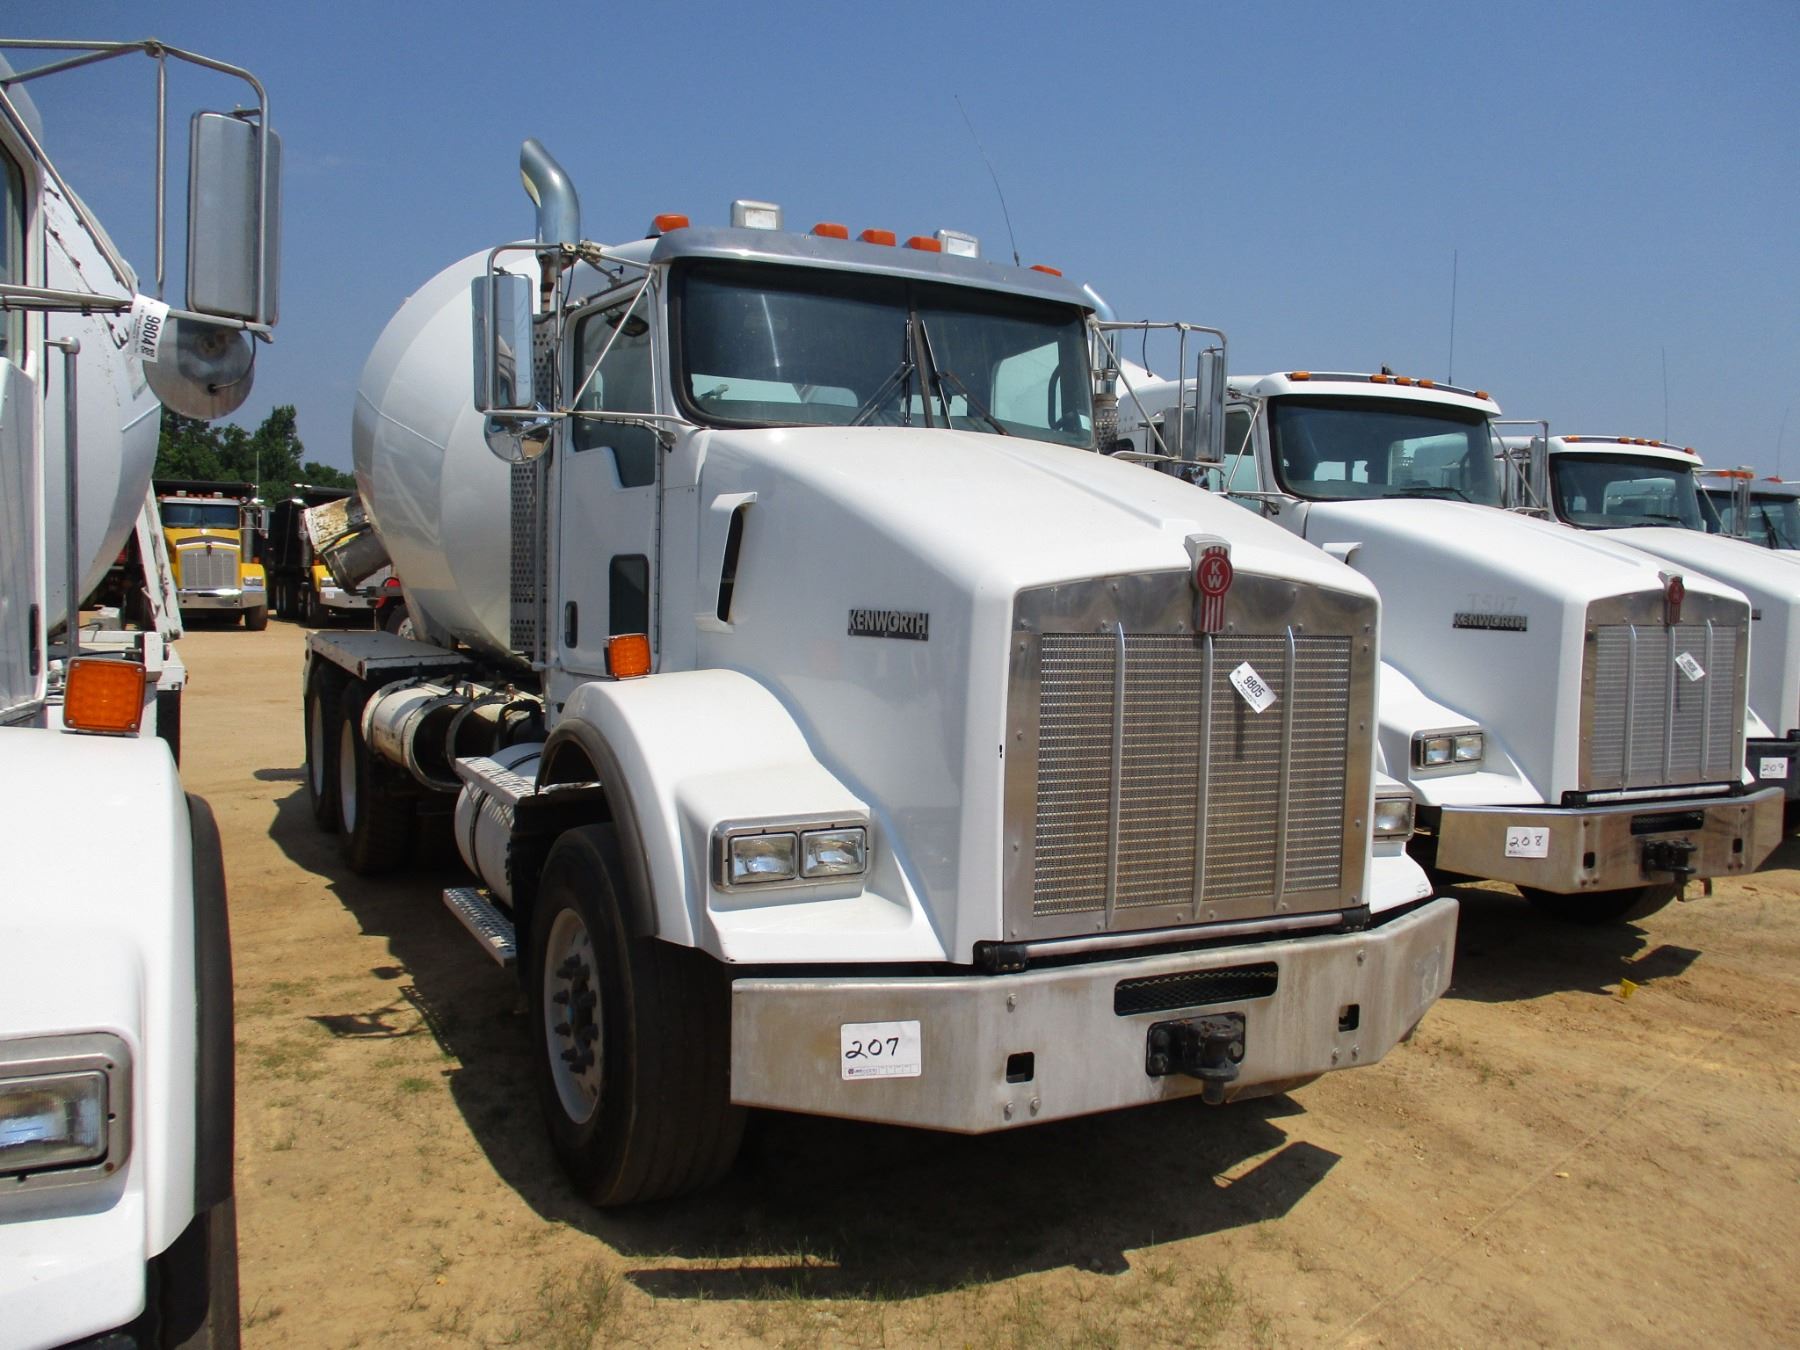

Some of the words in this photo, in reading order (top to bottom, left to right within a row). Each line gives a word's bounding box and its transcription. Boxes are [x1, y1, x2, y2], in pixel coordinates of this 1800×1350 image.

[141, 315, 161, 346] 9804
[848, 609, 928, 634] KENWORTH
[1454, 613, 1527, 628] KENWORTH
[1243, 675, 1266, 698] 9805
[1509, 835, 1543, 847] 208
[845, 1037, 899, 1059] 207
